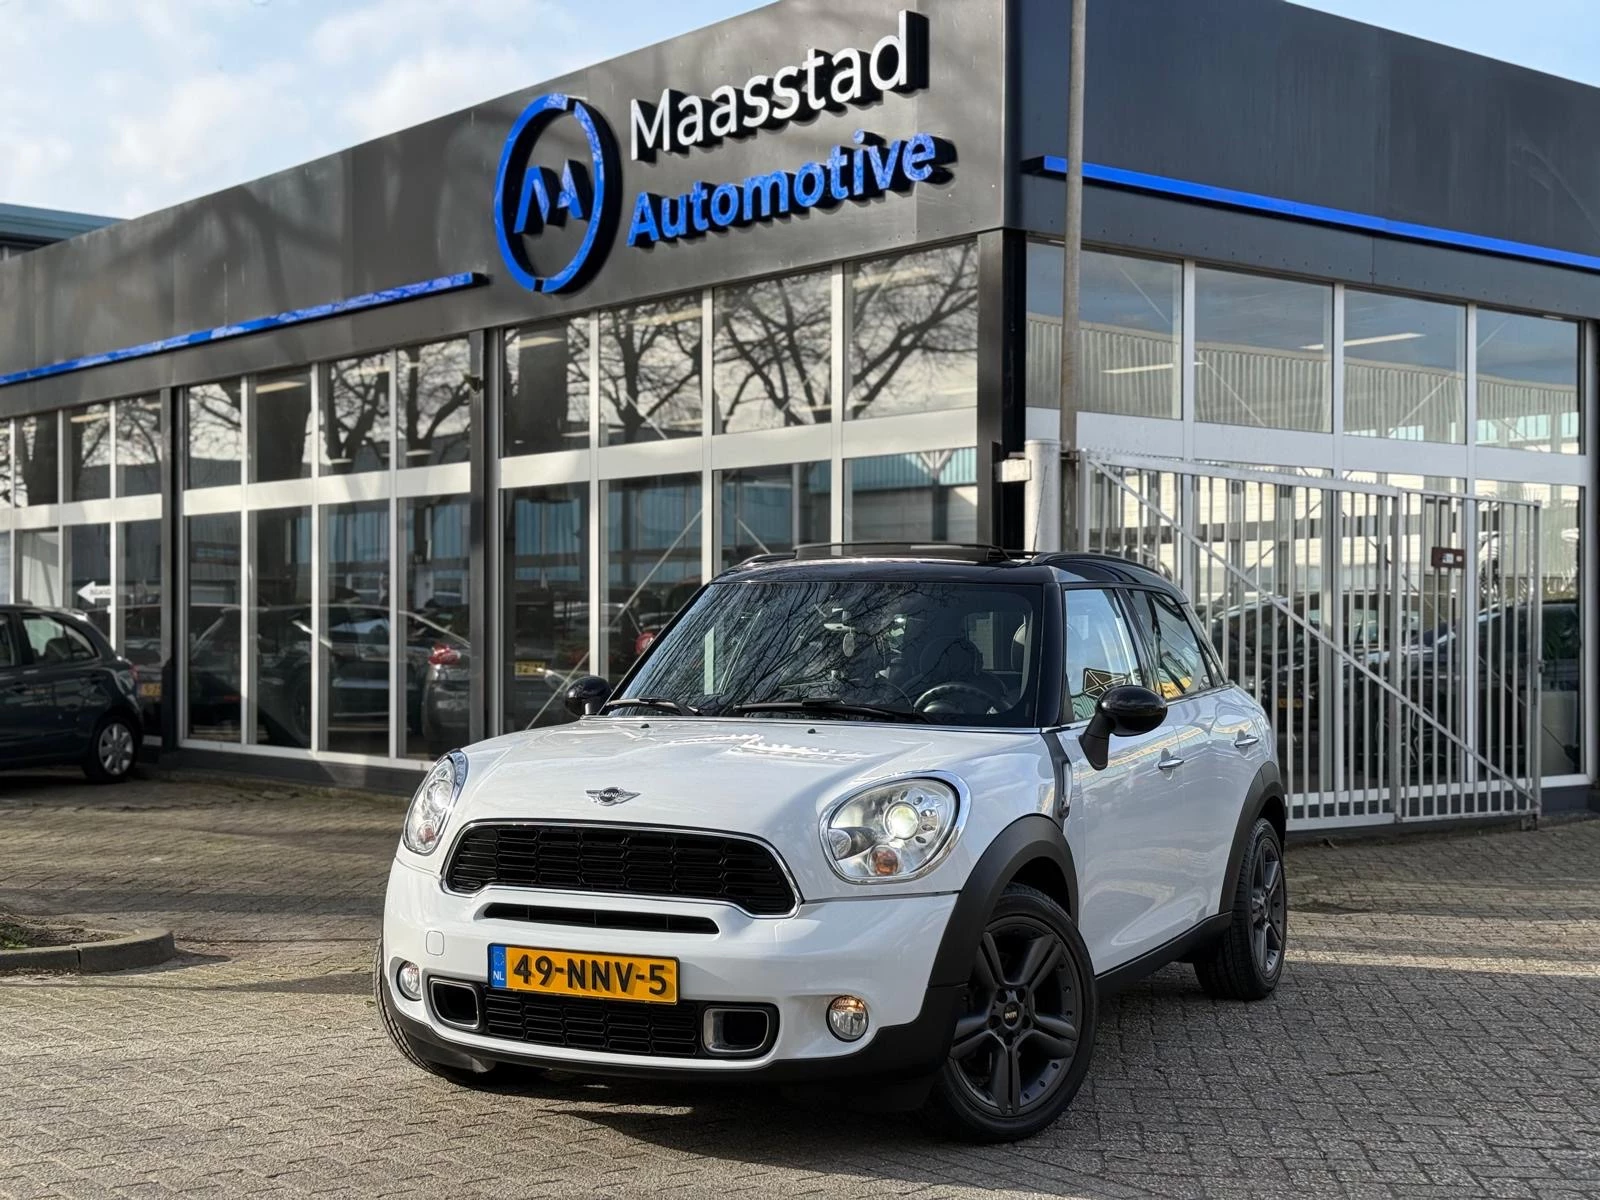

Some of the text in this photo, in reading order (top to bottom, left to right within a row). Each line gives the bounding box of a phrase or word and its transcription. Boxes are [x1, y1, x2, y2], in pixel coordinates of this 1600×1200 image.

[631, 10, 908, 160] Maasstad
[627, 129, 936, 247] Automotive
[493, 970, 504, 980] NL
[513, 954, 667, 995] 49-NNV-5
